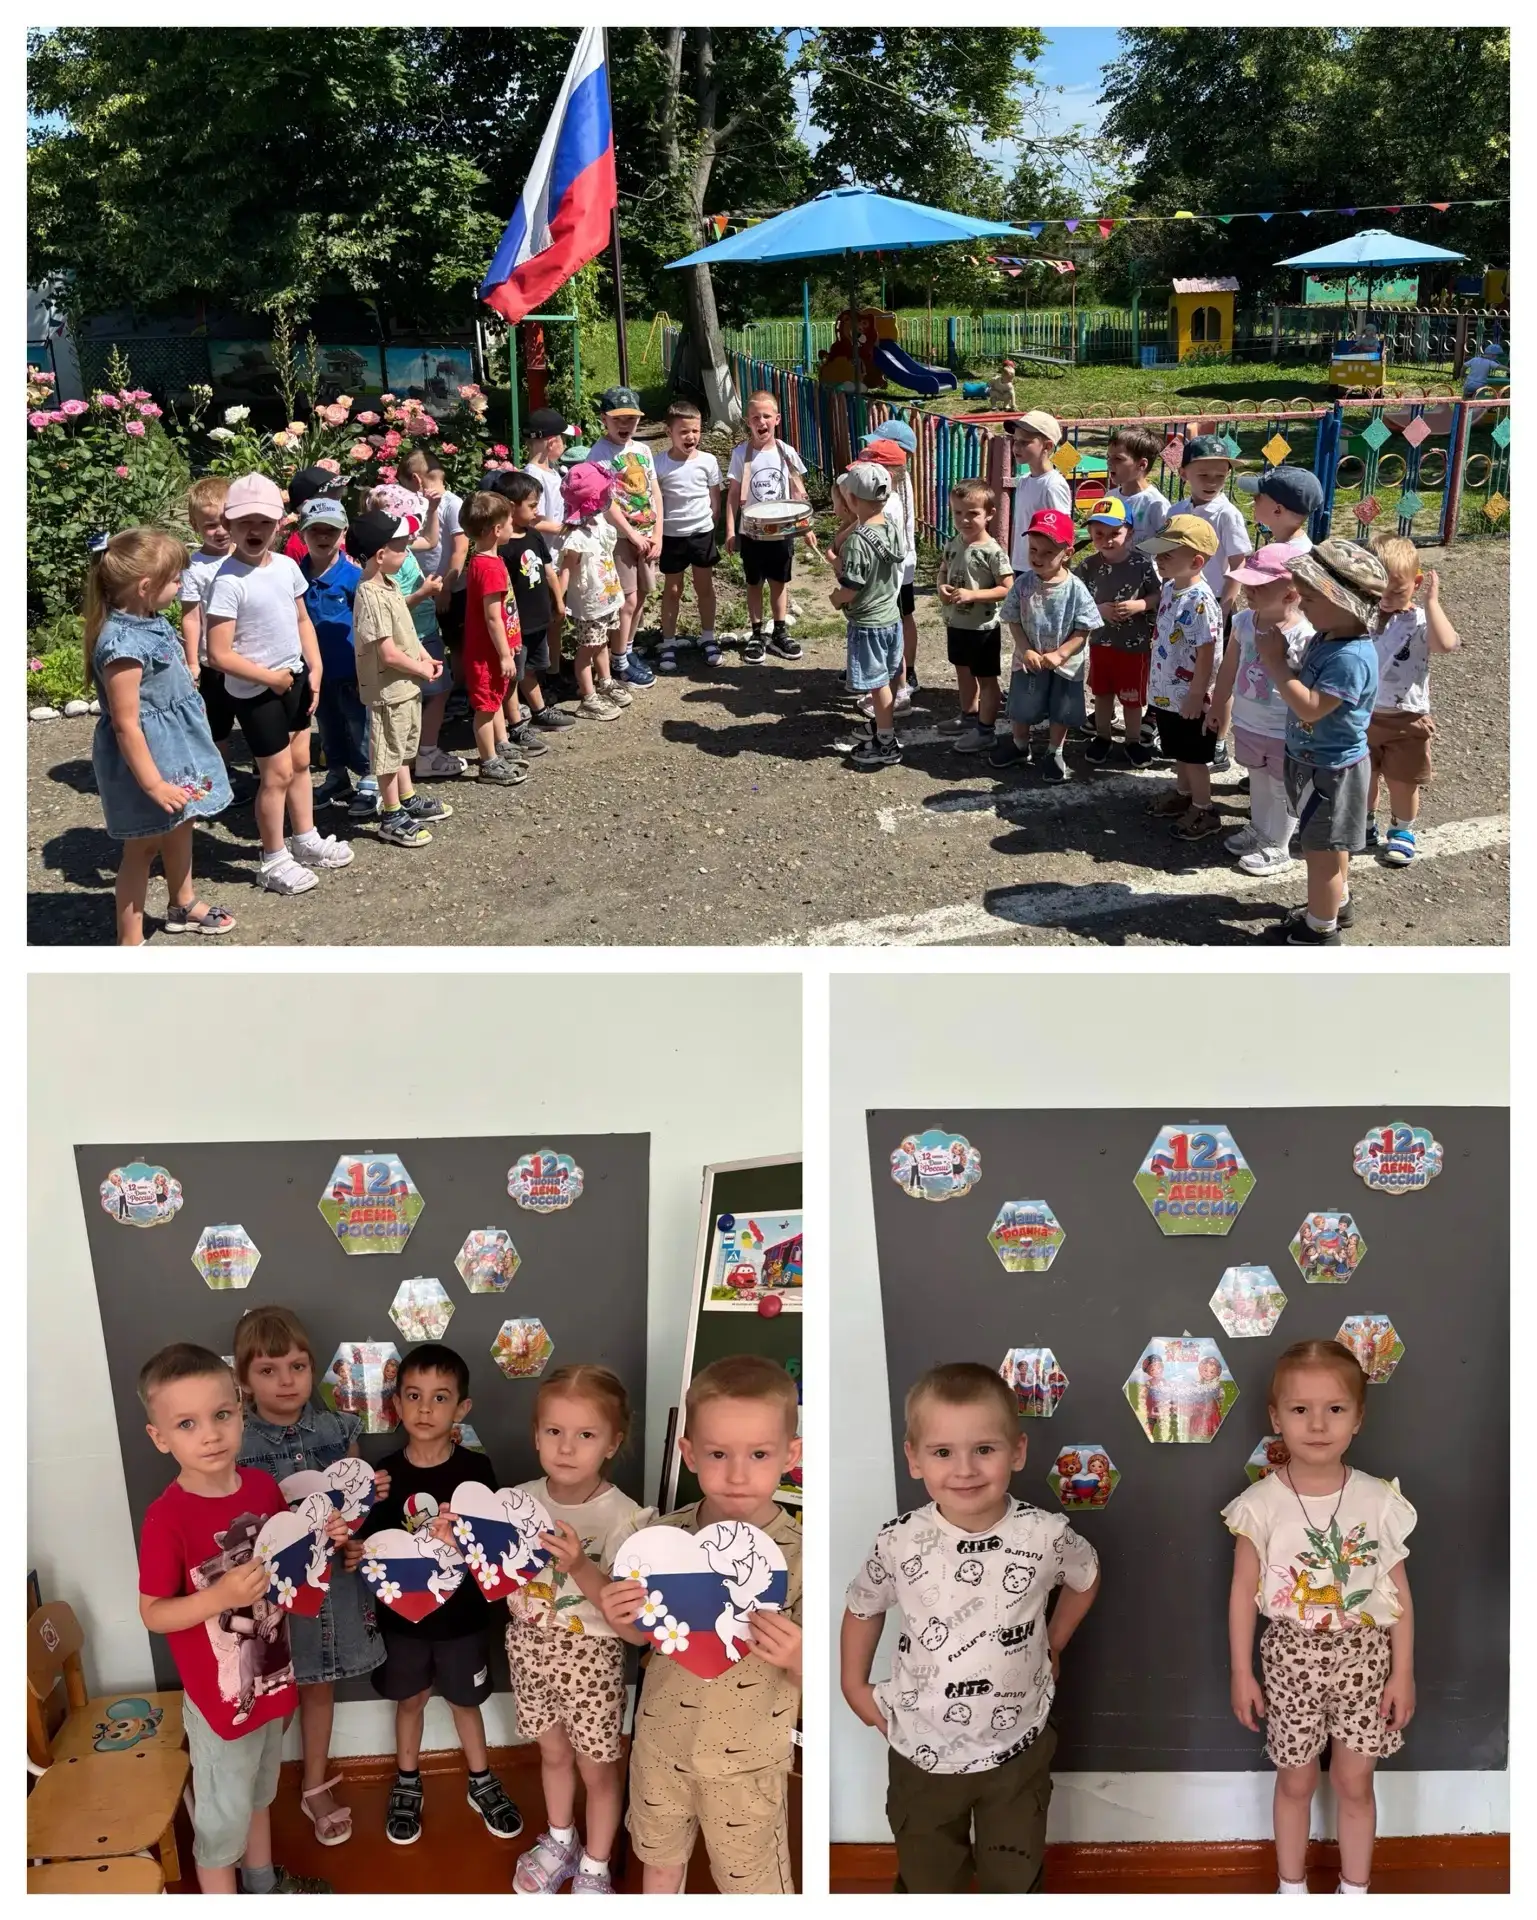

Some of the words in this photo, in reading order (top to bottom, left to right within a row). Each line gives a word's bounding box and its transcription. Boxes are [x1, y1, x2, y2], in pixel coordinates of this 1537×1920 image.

[753, 481, 771, 489] VANS
[1381, 1128, 1413, 1153] 12
[922, 1152, 931, 1160] 12
[1168, 1133, 1218, 1170] 12
[1380, 1154, 1415, 1162] ИЮНЯ
[531, 1155, 557, 1177] 12
[1380, 1162, 1416, 1174] ДЕНЬ
[348, 1162, 391, 1196] 12
[531, 1177, 560, 1185] ИЮНЯ
[1169, 1171, 1222, 1183] ИЮНЯ
[1369, 1172, 1425, 1185] РОССИИ
[530, 1185, 561, 1196] ДЕНЬ
[1169, 1184, 1224, 1200] ДЕНЬ
[349, 1197, 396, 1206] ИЮНЯ
[521, 1194, 569, 1205] РОССИИ
[350, 1208, 397, 1223] ДЕНЬ
[1154, 1199, 1239, 1217] РОССИИ
[1003, 1210, 1045, 1227] Наша
[337, 1221, 409, 1237] РОССИИ
[205, 1234, 242, 1249] Наша
[957, 1535, 1003, 1555] CITY
[1005, 1547, 1043, 1561] future
[948, 1630, 986, 1662] future
[945, 1679, 993, 1699] CITY
[994, 1691, 1027, 1699] future
